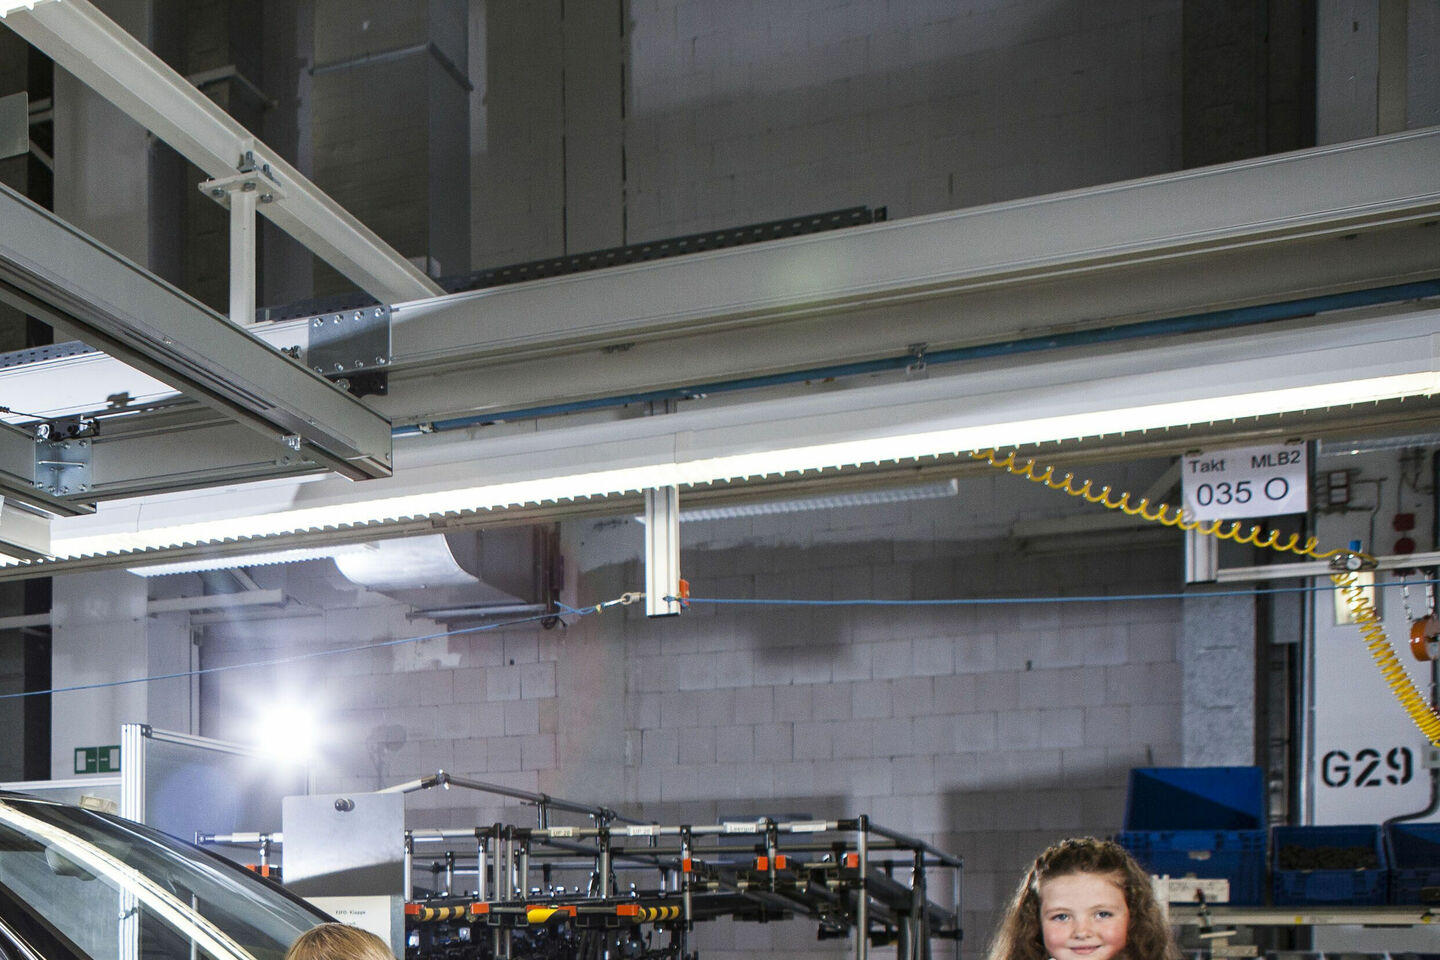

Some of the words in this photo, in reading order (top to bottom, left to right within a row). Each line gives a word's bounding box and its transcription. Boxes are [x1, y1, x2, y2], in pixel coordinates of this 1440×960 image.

[1189, 459, 1226, 473] Takt
[1251, 450, 1301, 469] MLB2
[1196, 480, 1252, 507] 035
[1322, 746, 1413, 788] G29
